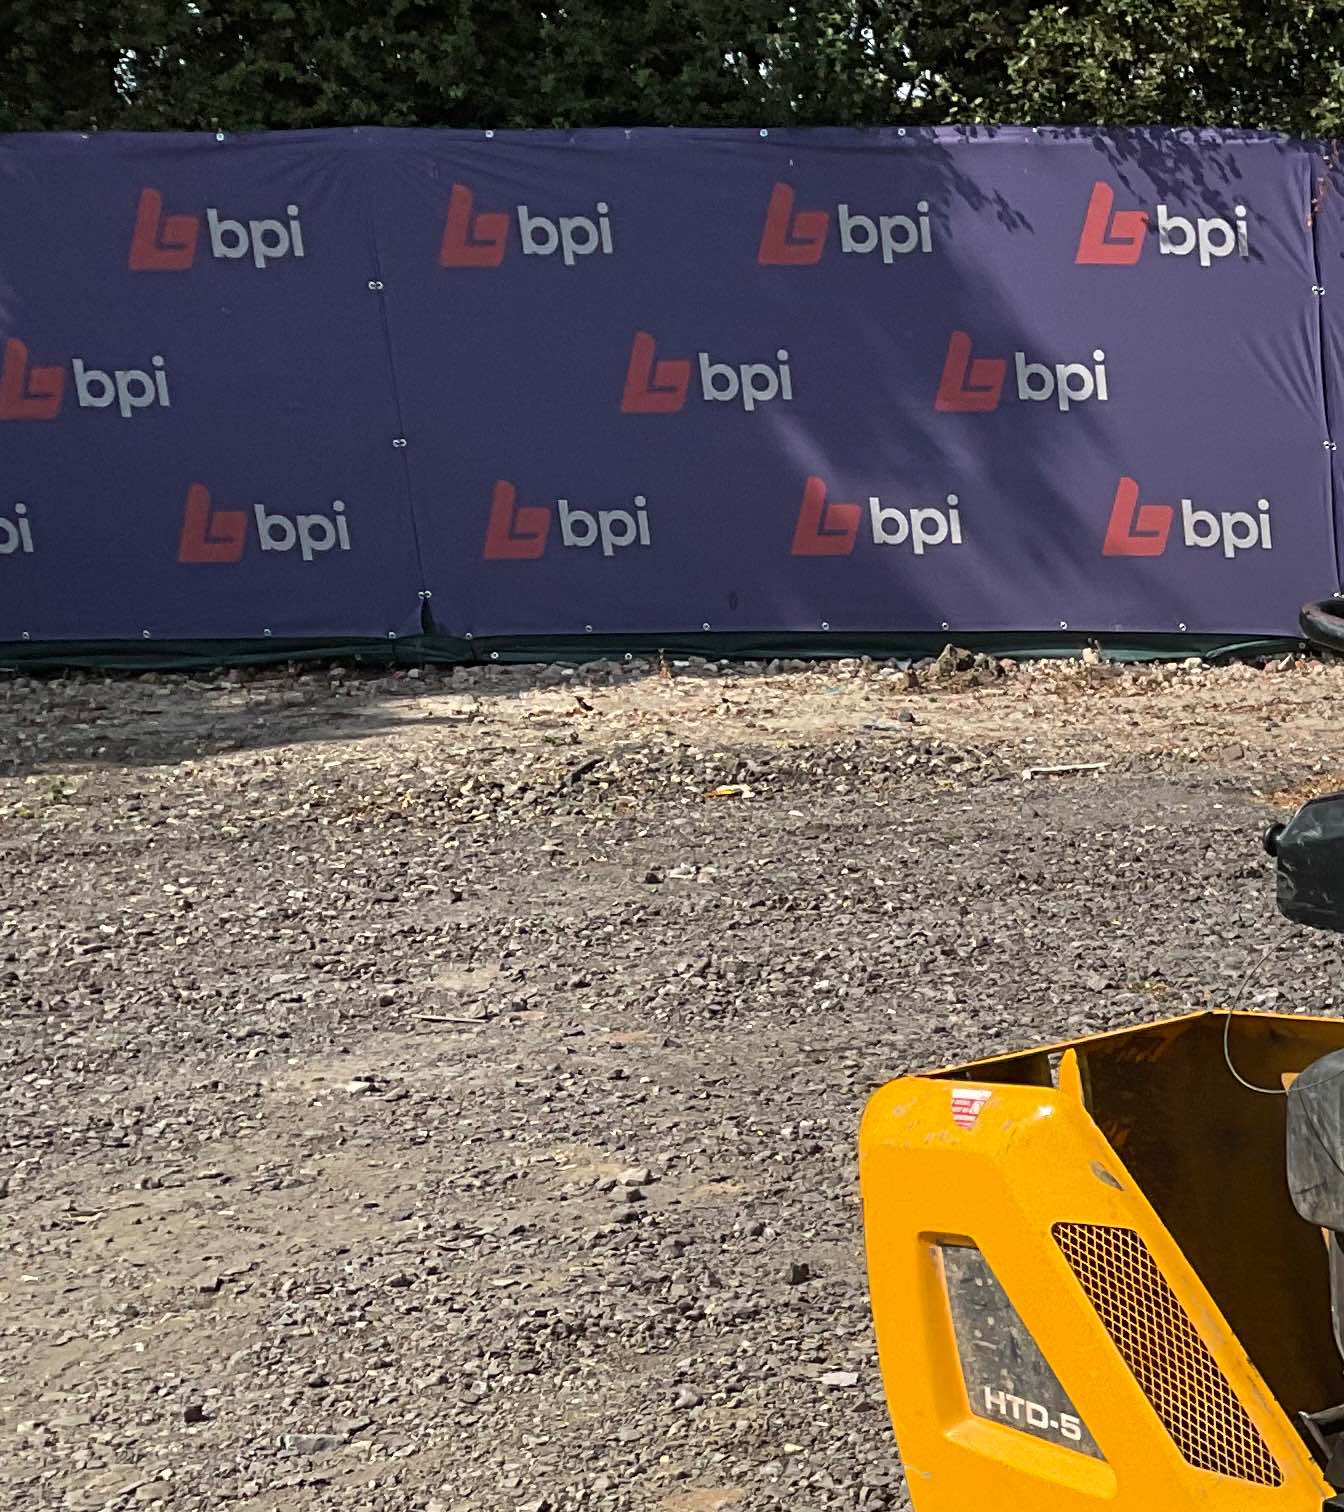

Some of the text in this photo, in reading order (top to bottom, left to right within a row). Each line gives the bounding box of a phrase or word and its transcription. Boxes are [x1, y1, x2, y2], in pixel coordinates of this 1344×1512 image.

[207, 205, 304, 268] bpi
[517, 202, 612, 265] bpi
[838, 201, 932, 263] bpi
[1157, 205, 1247, 266] bpi
[72, 356, 170, 417] bpi
[699, 350, 792, 410] bpi
[1015, 350, 1107, 410] bpi
[254, 501, 350, 560] bpi
[558, 496, 650, 556] bpi
[870, 495, 962, 554] bpi
[1182, 499, 1271, 557] bpi
[984, 1386, 1081, 1441] HTD-5
